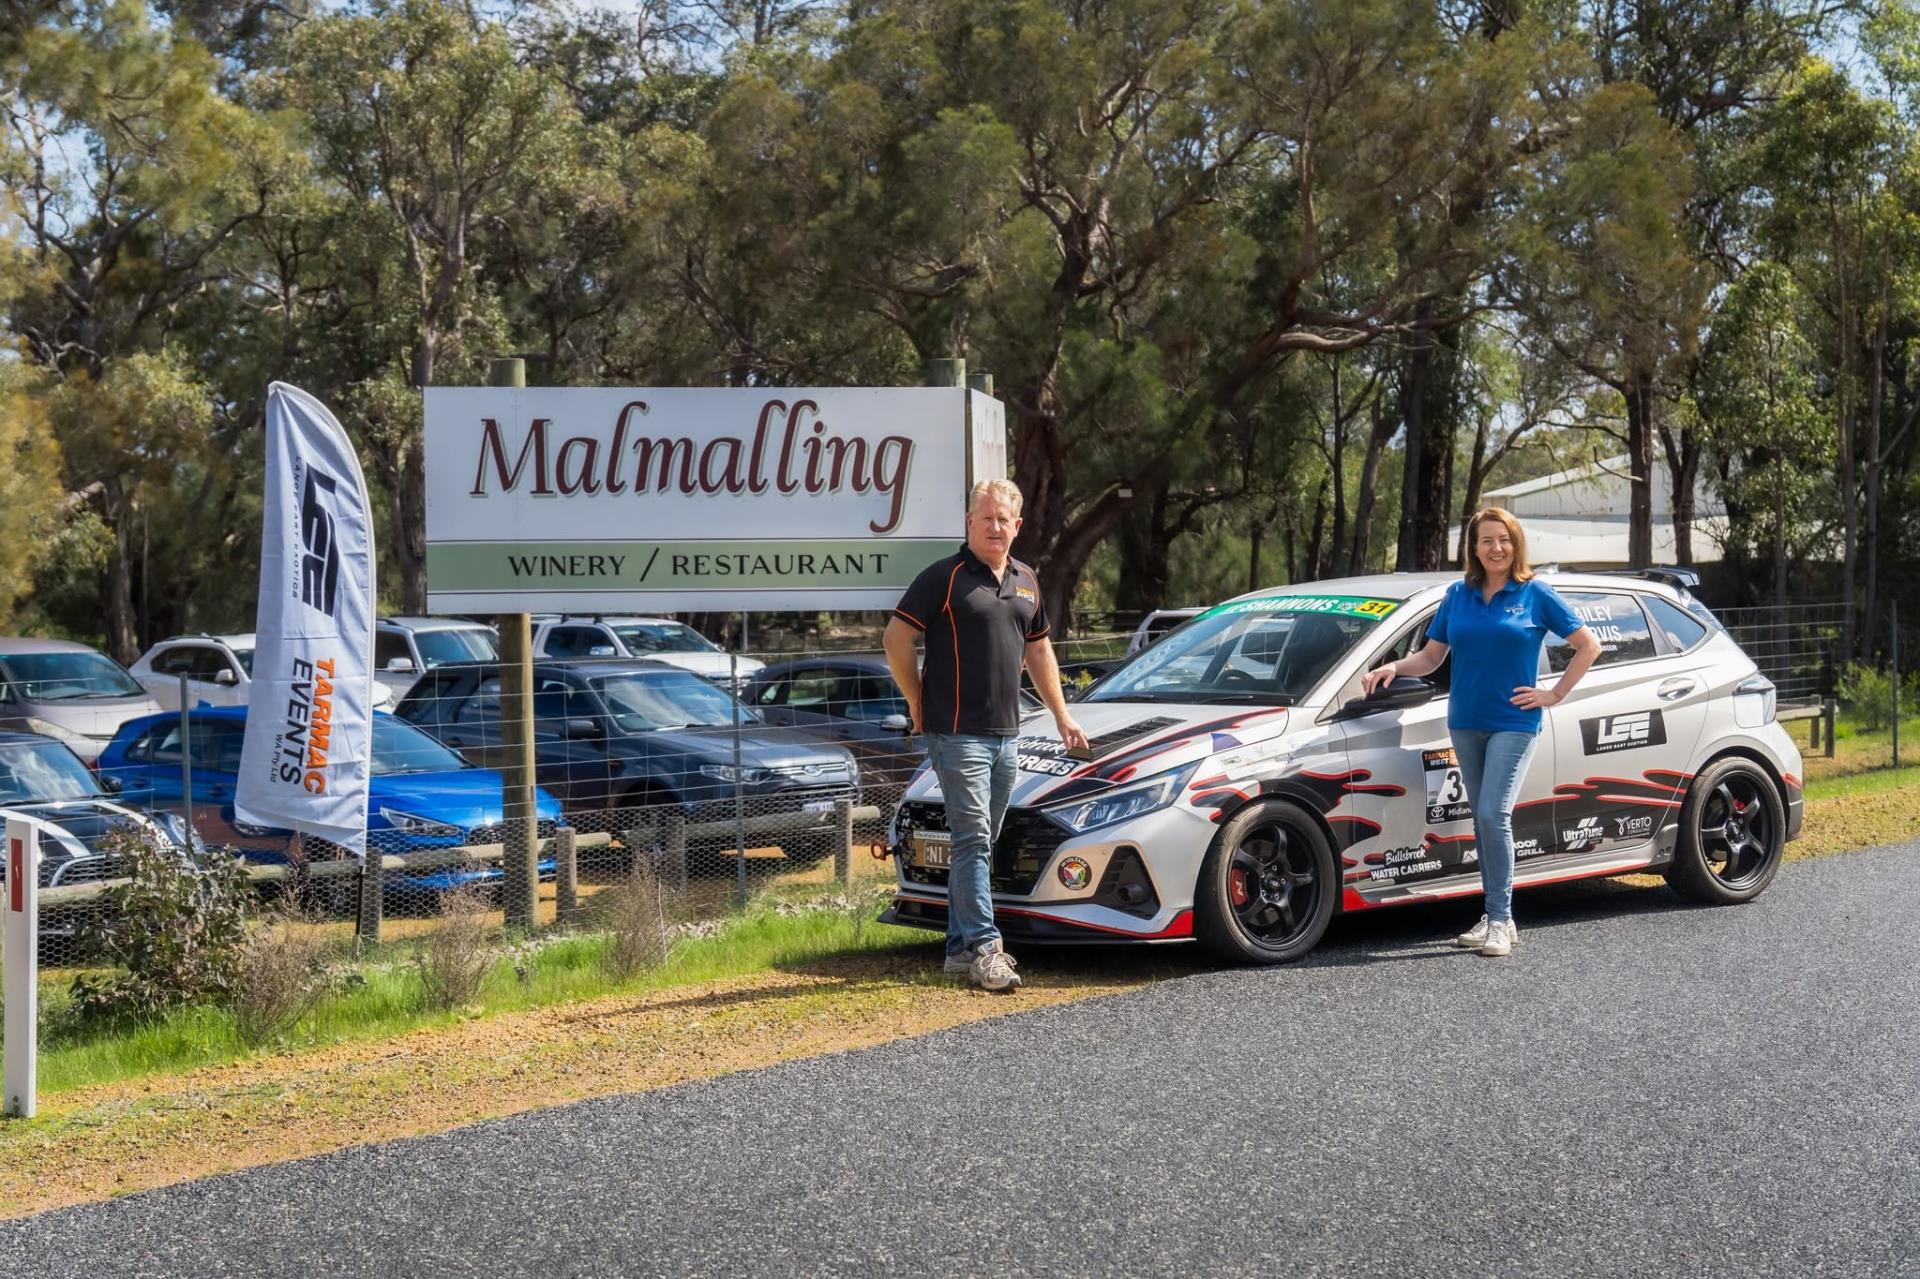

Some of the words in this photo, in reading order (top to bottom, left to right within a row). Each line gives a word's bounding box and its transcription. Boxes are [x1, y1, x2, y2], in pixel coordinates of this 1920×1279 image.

[469, 399, 914, 533] Malmalling
[508, 555, 626, 577] WINERY
[672, 553, 889, 575] RESTAURANT
[1240, 598, 1339, 612] SHANNONS
[1360, 602, 1391, 614] 31
[1574, 605, 1613, 621] AILEY
[1591, 625, 1622, 641] RVIS
[280, 657, 313, 785] EVENTS
[304, 657, 335, 795] TARMAC
[1598, 712, 1650, 744] LEE
[1017, 755, 1075, 775] RRIERS
[1447, 770, 1463, 802] 3
[1448, 807, 1472, 816] Midlan
[1626, 816, 1651, 830] VERTO
[1513, 839, 1538, 849] ROOF
[1517, 847, 1545, 857] GRILL
[1385, 846, 1426, 865] Bullsbrook
[1371, 867, 1400, 880] WATER
[1401, 860, 1442, 876] CARRIERS
